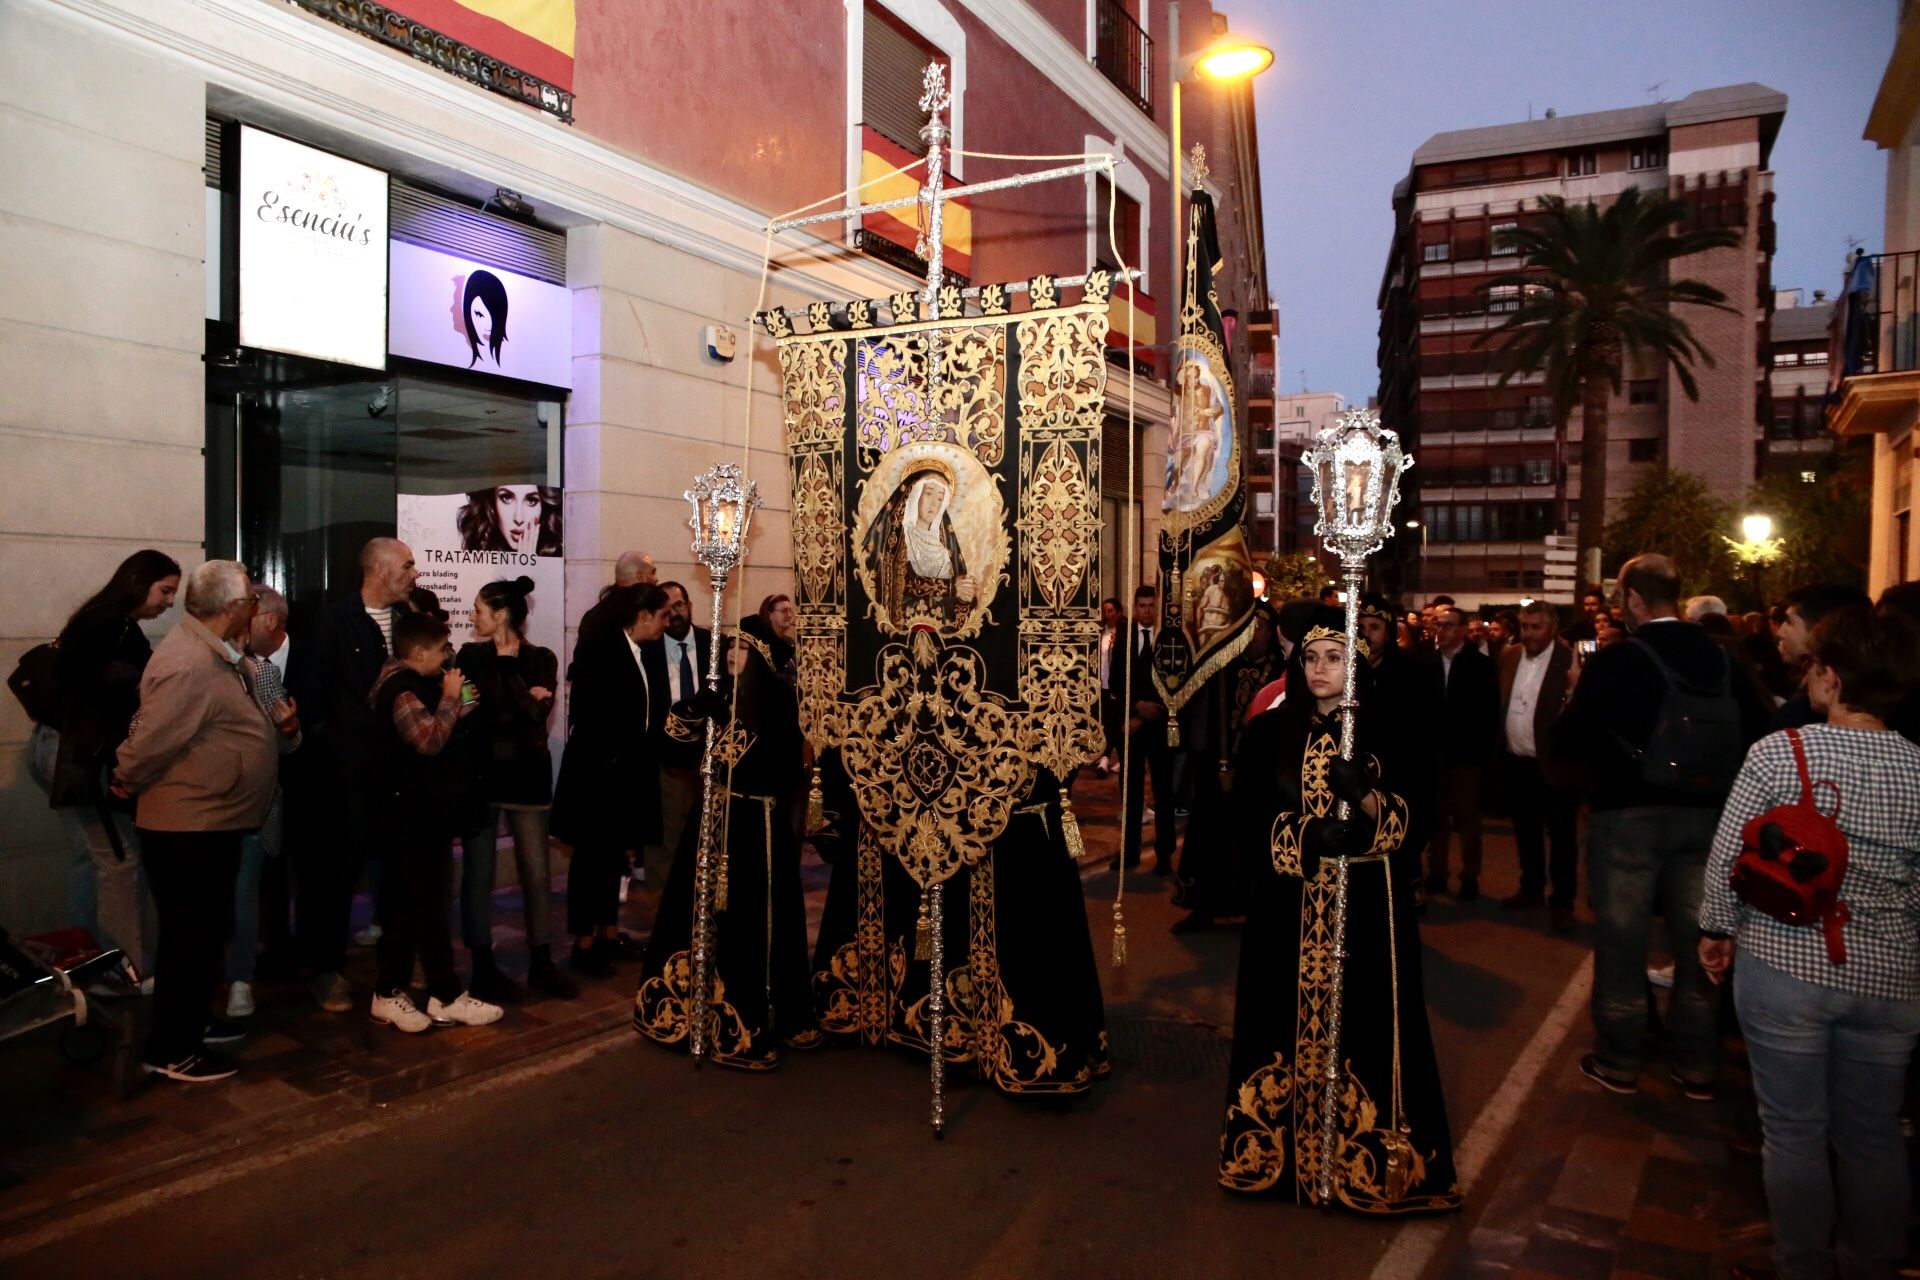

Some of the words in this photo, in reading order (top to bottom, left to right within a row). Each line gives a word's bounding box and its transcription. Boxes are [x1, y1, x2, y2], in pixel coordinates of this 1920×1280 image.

[257, 190, 371, 246] Esencia's
[425, 549, 537, 566] TRATAMIENTOS
[432, 570, 458, 580] blading
[416, 582, 457, 592] icroshading
[440, 595, 462, 603] stañas
